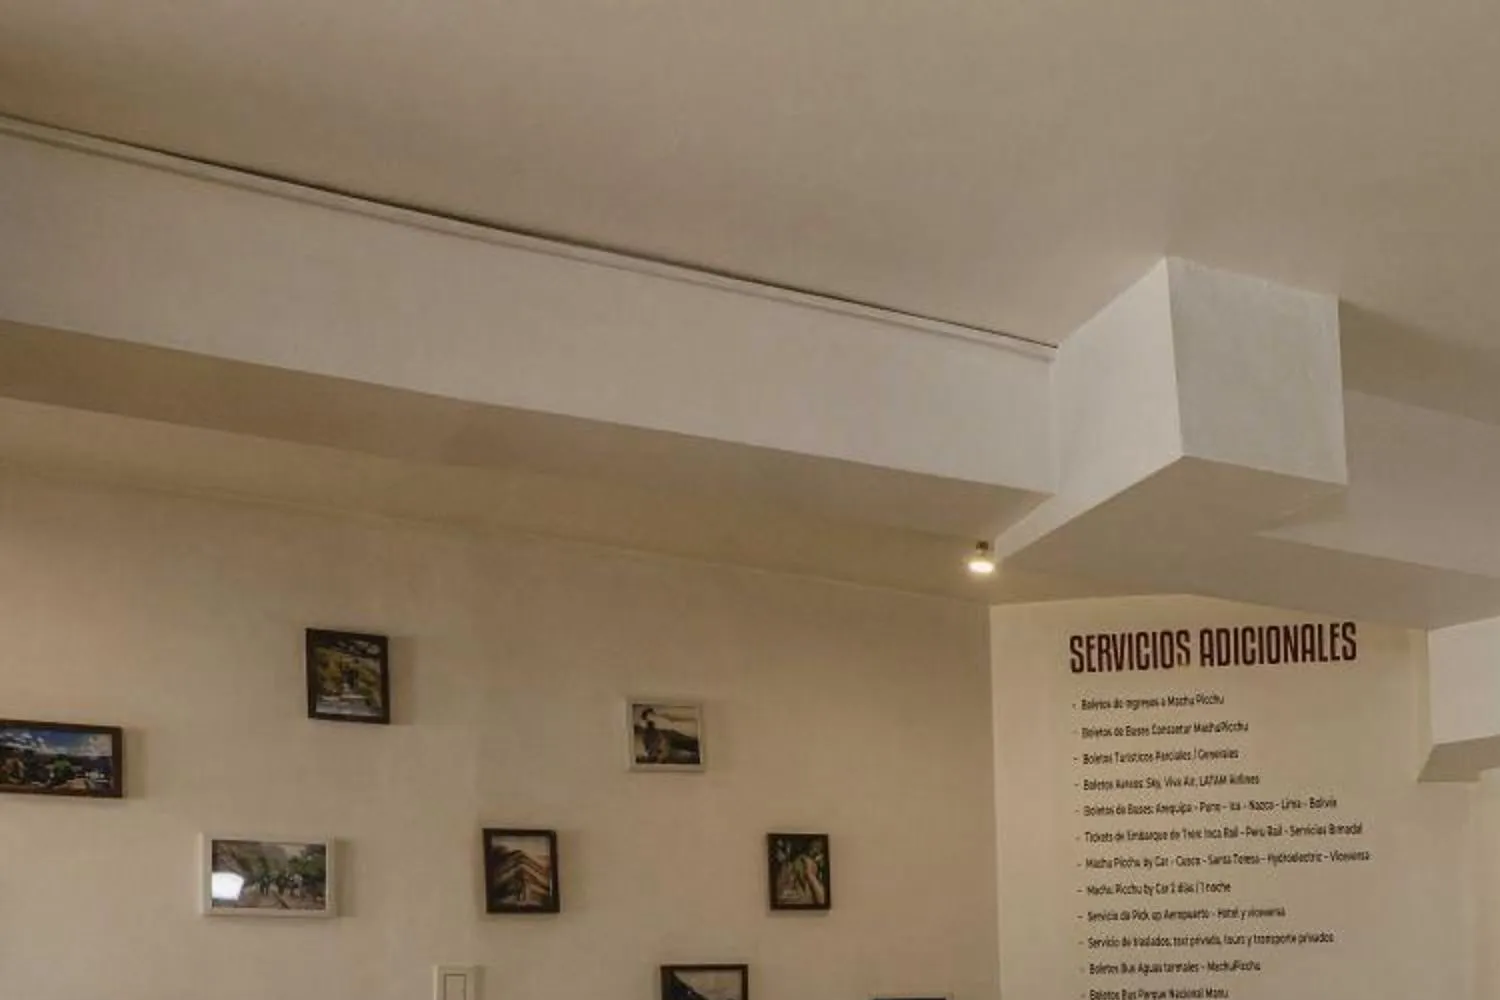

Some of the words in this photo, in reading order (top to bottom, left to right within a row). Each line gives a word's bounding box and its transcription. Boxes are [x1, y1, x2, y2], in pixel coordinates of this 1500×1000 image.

[1069, 629, 1191, 674] SERVICIOS
[1199, 622, 1357, 668] ADICIONALES
[1196, 693, 1225, 705] Picchu
[1083, 752, 1112, 765] Boletos
[1083, 779, 1114, 792] Boletos
[1199, 774, 1227, 787] LATAM
[1156, 801, 1192, 816] Arequipa
[1281, 797, 1302, 811] Lima
[1085, 831, 1113, 844] Tickets
[1115, 883, 1143, 896] Picchu
